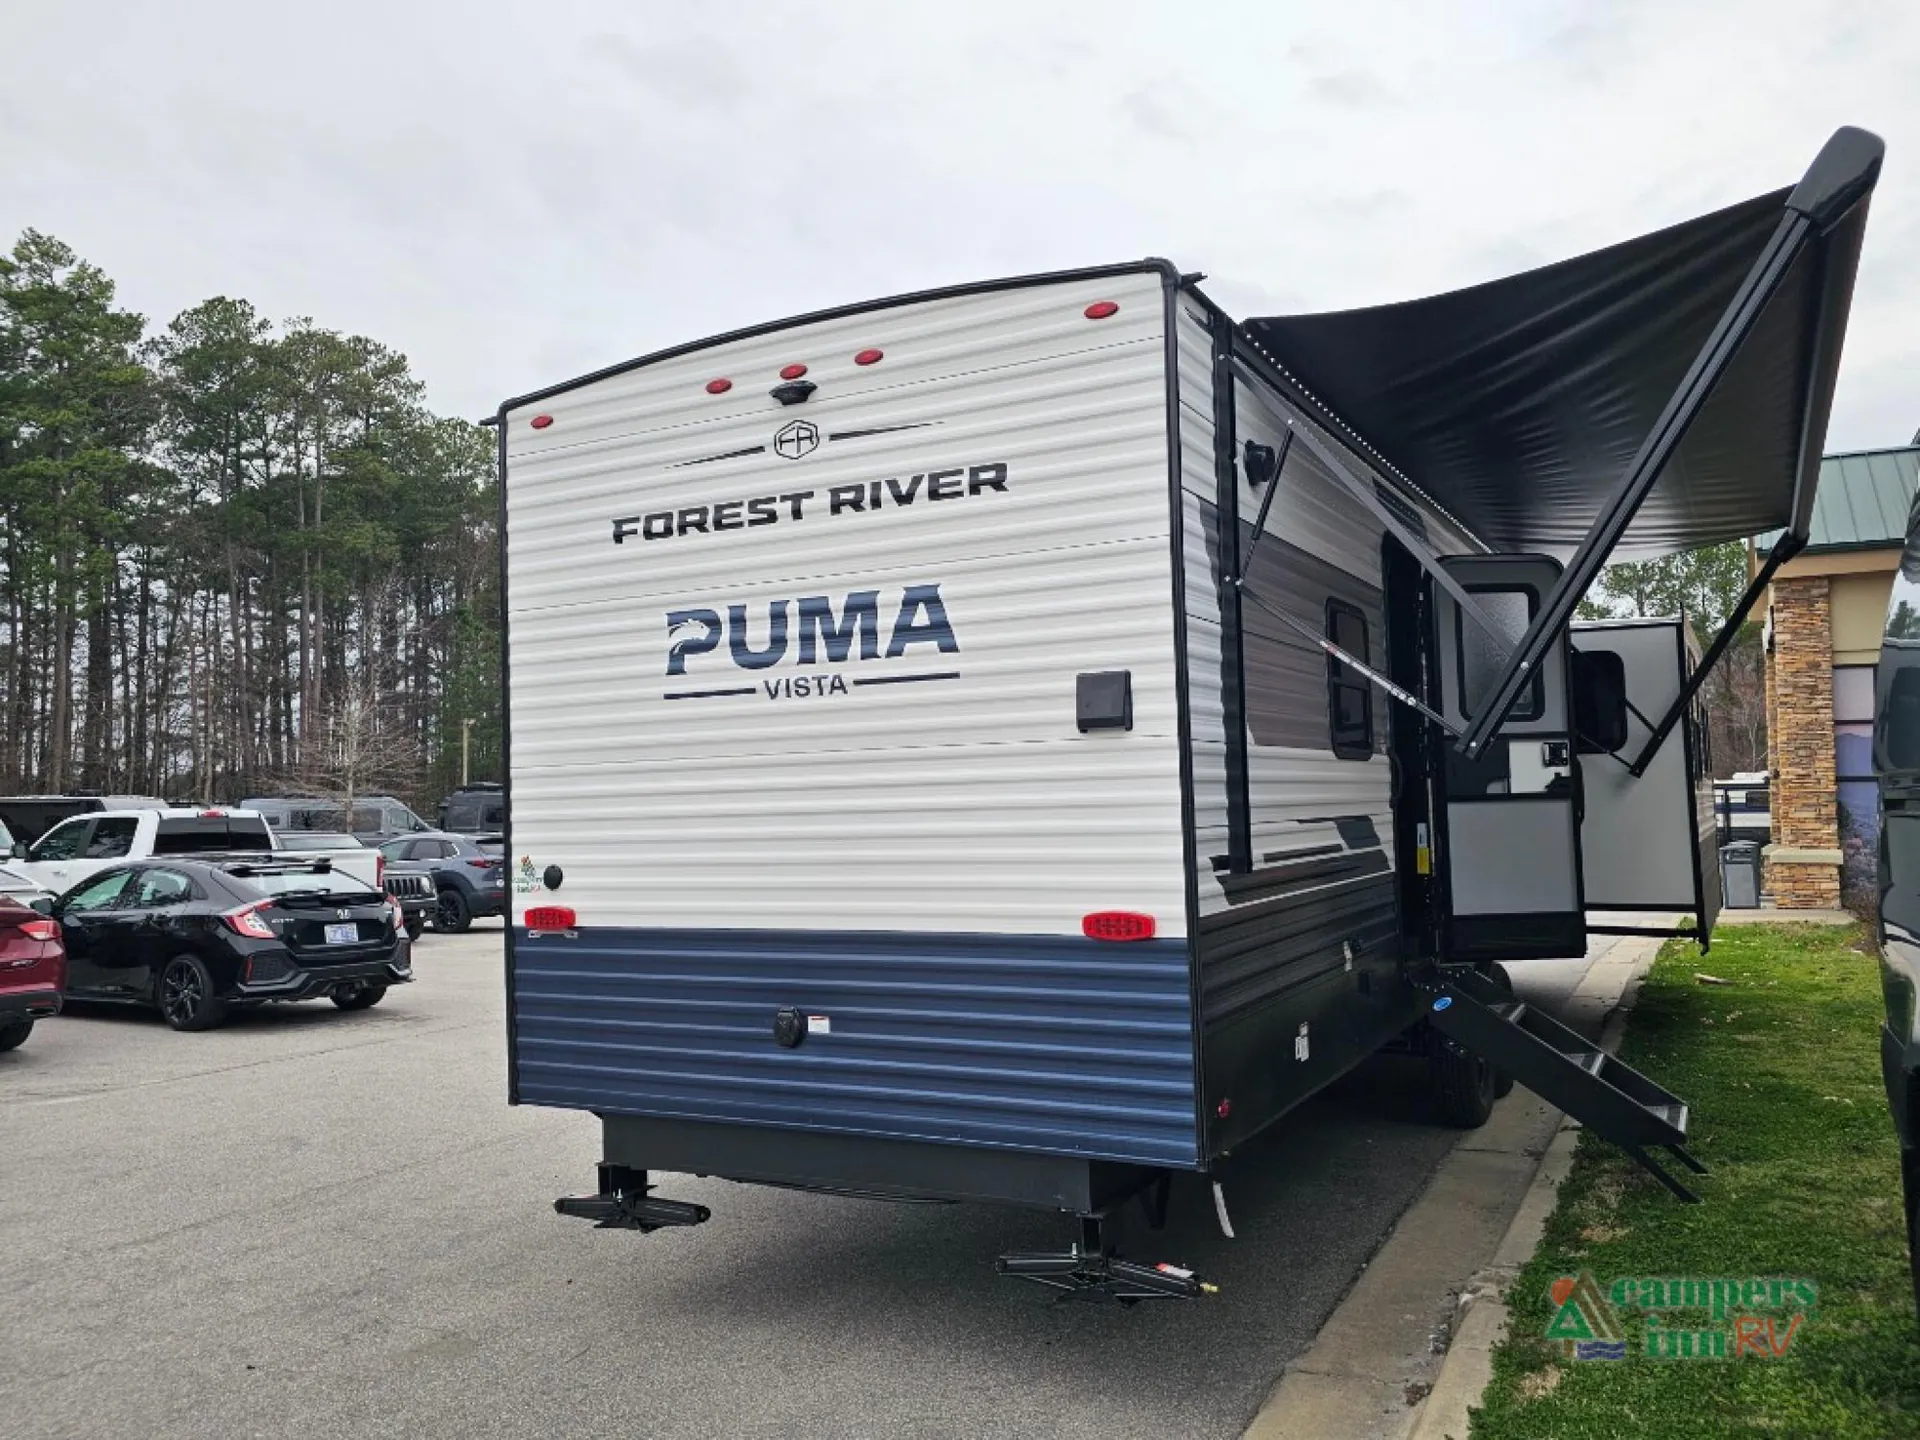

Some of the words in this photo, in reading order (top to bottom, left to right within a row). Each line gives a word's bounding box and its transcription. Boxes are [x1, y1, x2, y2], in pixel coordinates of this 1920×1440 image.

[612, 491, 814, 543] FOREST
[828, 463, 1009, 515] RIVER
[665, 584, 960, 675] PUMA
[765, 674, 848, 700] VISTA
